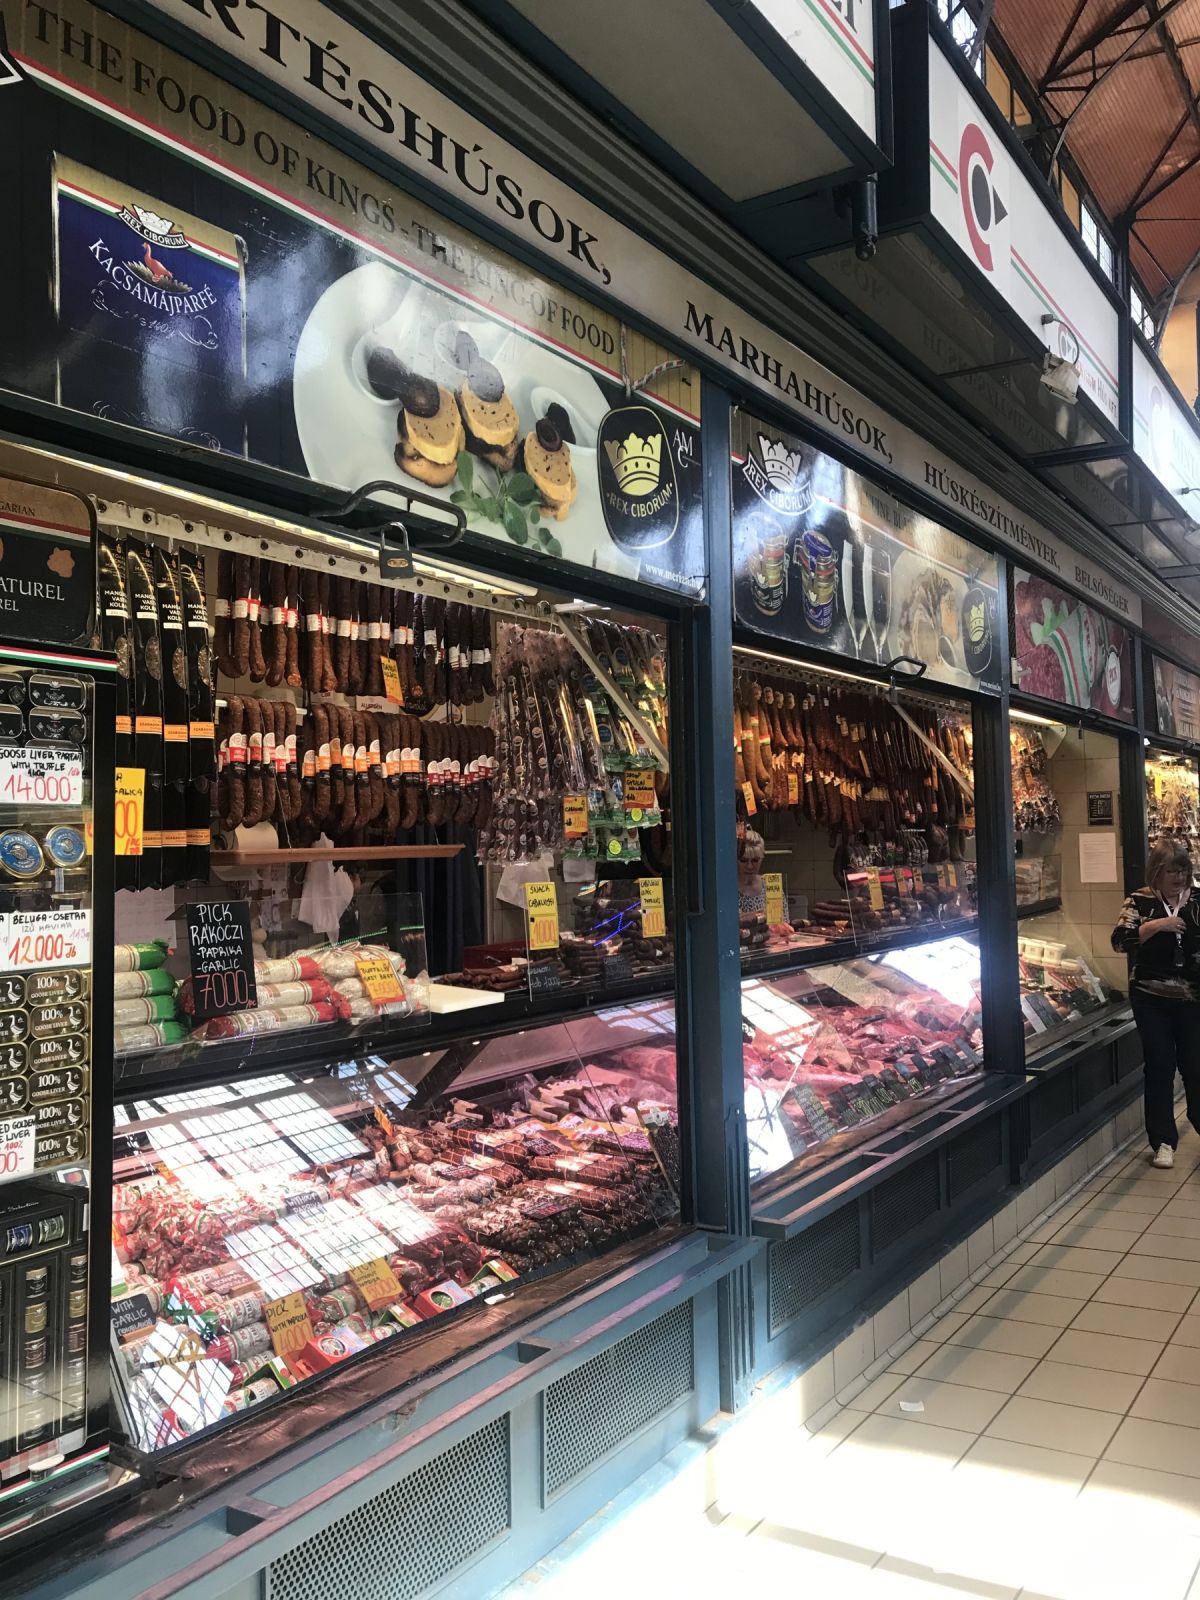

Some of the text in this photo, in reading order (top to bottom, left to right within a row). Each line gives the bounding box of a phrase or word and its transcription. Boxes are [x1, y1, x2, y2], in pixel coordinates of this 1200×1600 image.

[27, 1, 124, 84] THE
[131, 57, 246, 147] FOOD
[254, 131, 300, 177] OF
[306, 161, 396, 234] KINGS
[411, 220, 466, 274] THE
[560, 305, 615, 355] FOOD
[124, 213, 184, 246] REX CIBORUM
[88, 236, 218, 318] KACSAMÁJPARFÉ
[683, 300, 894, 465] MARHAHÚSOK,
[923, 460, 1061, 570] HÚSKÉSZÍTMÉNYEK,
[1074, 565, 1130, 614] BELSŐSÉGEK
[748, 462, 813, 511] REX CIBORUM
[609, 486, 673, 518] REX CIBORUM
[29, 749, 54, 760] LIVER
[10, 761, 31, 770] WITH
[12, 913, 47, 925] BELUGA
[52, 911, 87, 921] OSETRA
[196, 903, 233, 923] PICK
[190, 923, 244, 946] RÁKÓCZI
[36, 976, 60, 989] 100%
[40, 1008, 64, 1022] 100%
[39, 1041, 63, 1055] 100%
[38, 1073, 61, 1088] 100%
[38, 1106, 62, 1120] 100%
[35, 1121, 51, 1130] OOSE
[6, 1129, 31, 1141] LIVER
[37, 1139, 61, 1153] 100%
[35, 1154, 50, 1162] OOSE
[111, 1299, 135, 1315] WITH
[266, 1299, 289, 1319] PICK
[111, 1307, 148, 1329] GARLIC
